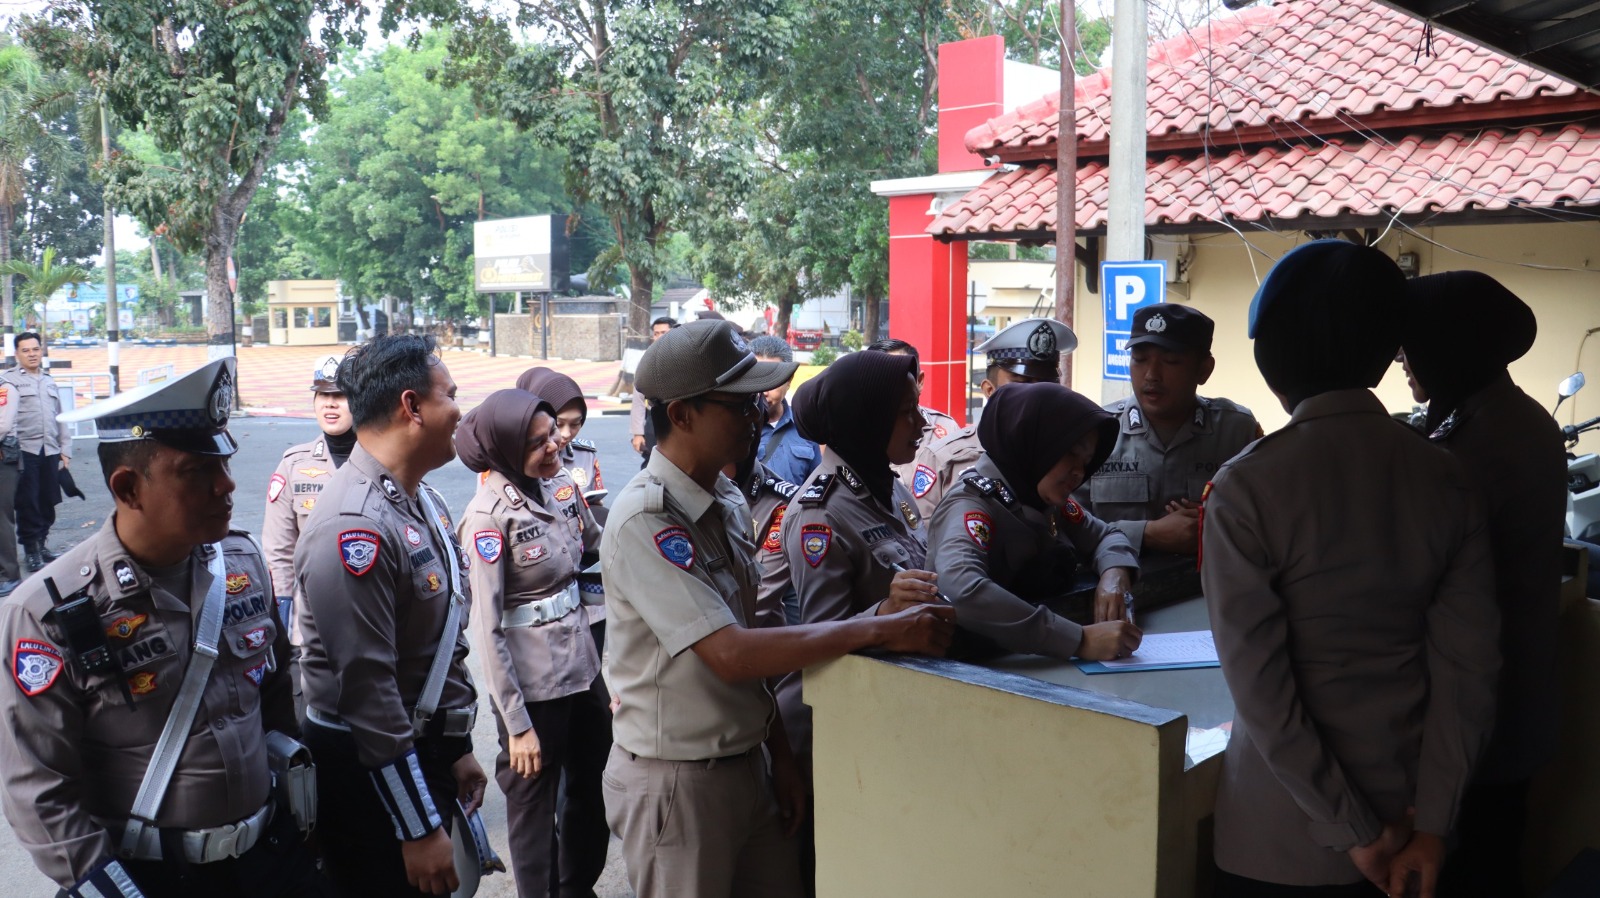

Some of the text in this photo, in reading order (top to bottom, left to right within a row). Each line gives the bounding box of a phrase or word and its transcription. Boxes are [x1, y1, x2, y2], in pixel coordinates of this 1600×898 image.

[1115, 275, 1146, 320] P
[341, 532, 377, 541] LALU LINTAS
[223, 595, 267, 624] POLRI
